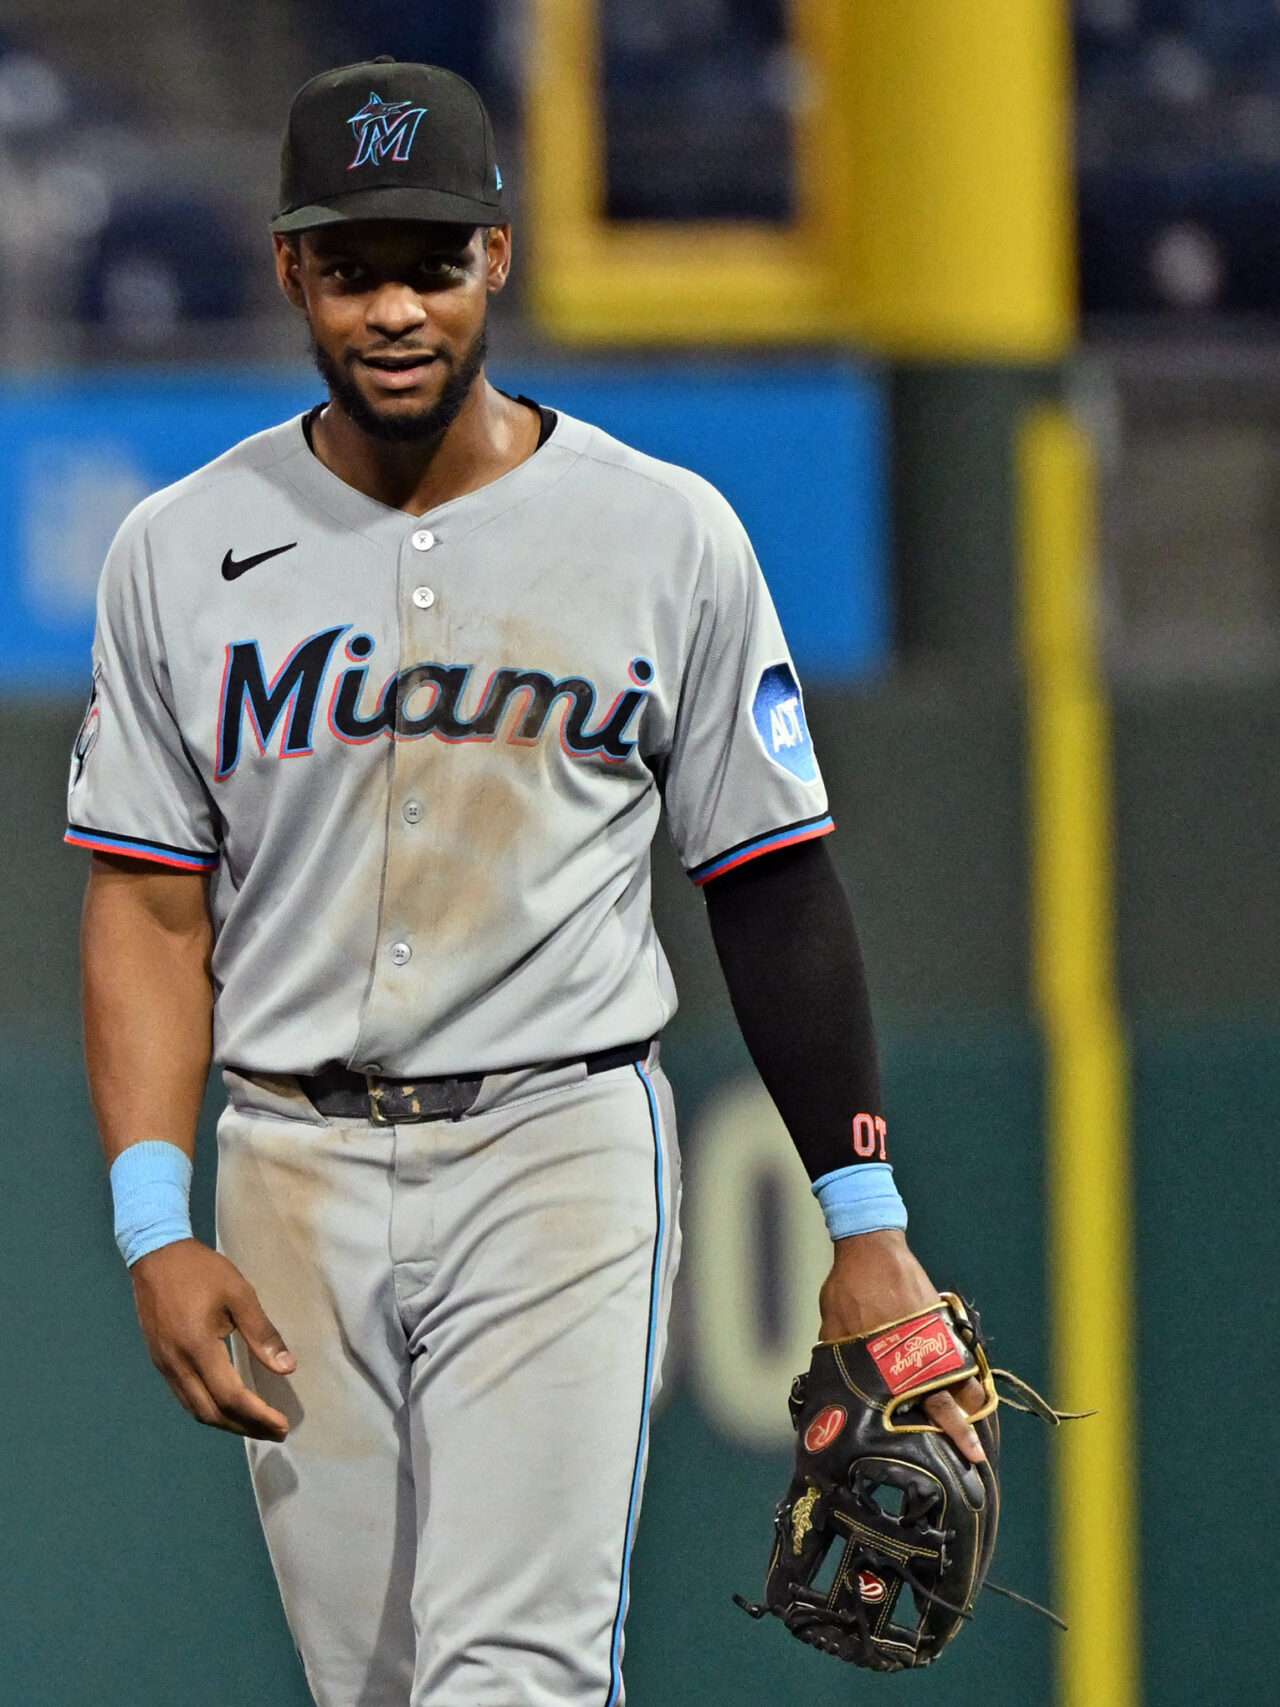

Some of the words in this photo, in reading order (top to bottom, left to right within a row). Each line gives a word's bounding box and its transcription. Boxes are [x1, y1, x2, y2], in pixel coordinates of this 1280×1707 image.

[214, 624, 655, 782] Miami
[769, 697, 803, 753] ADT
[889, 1332, 947, 1376] Rawlings
